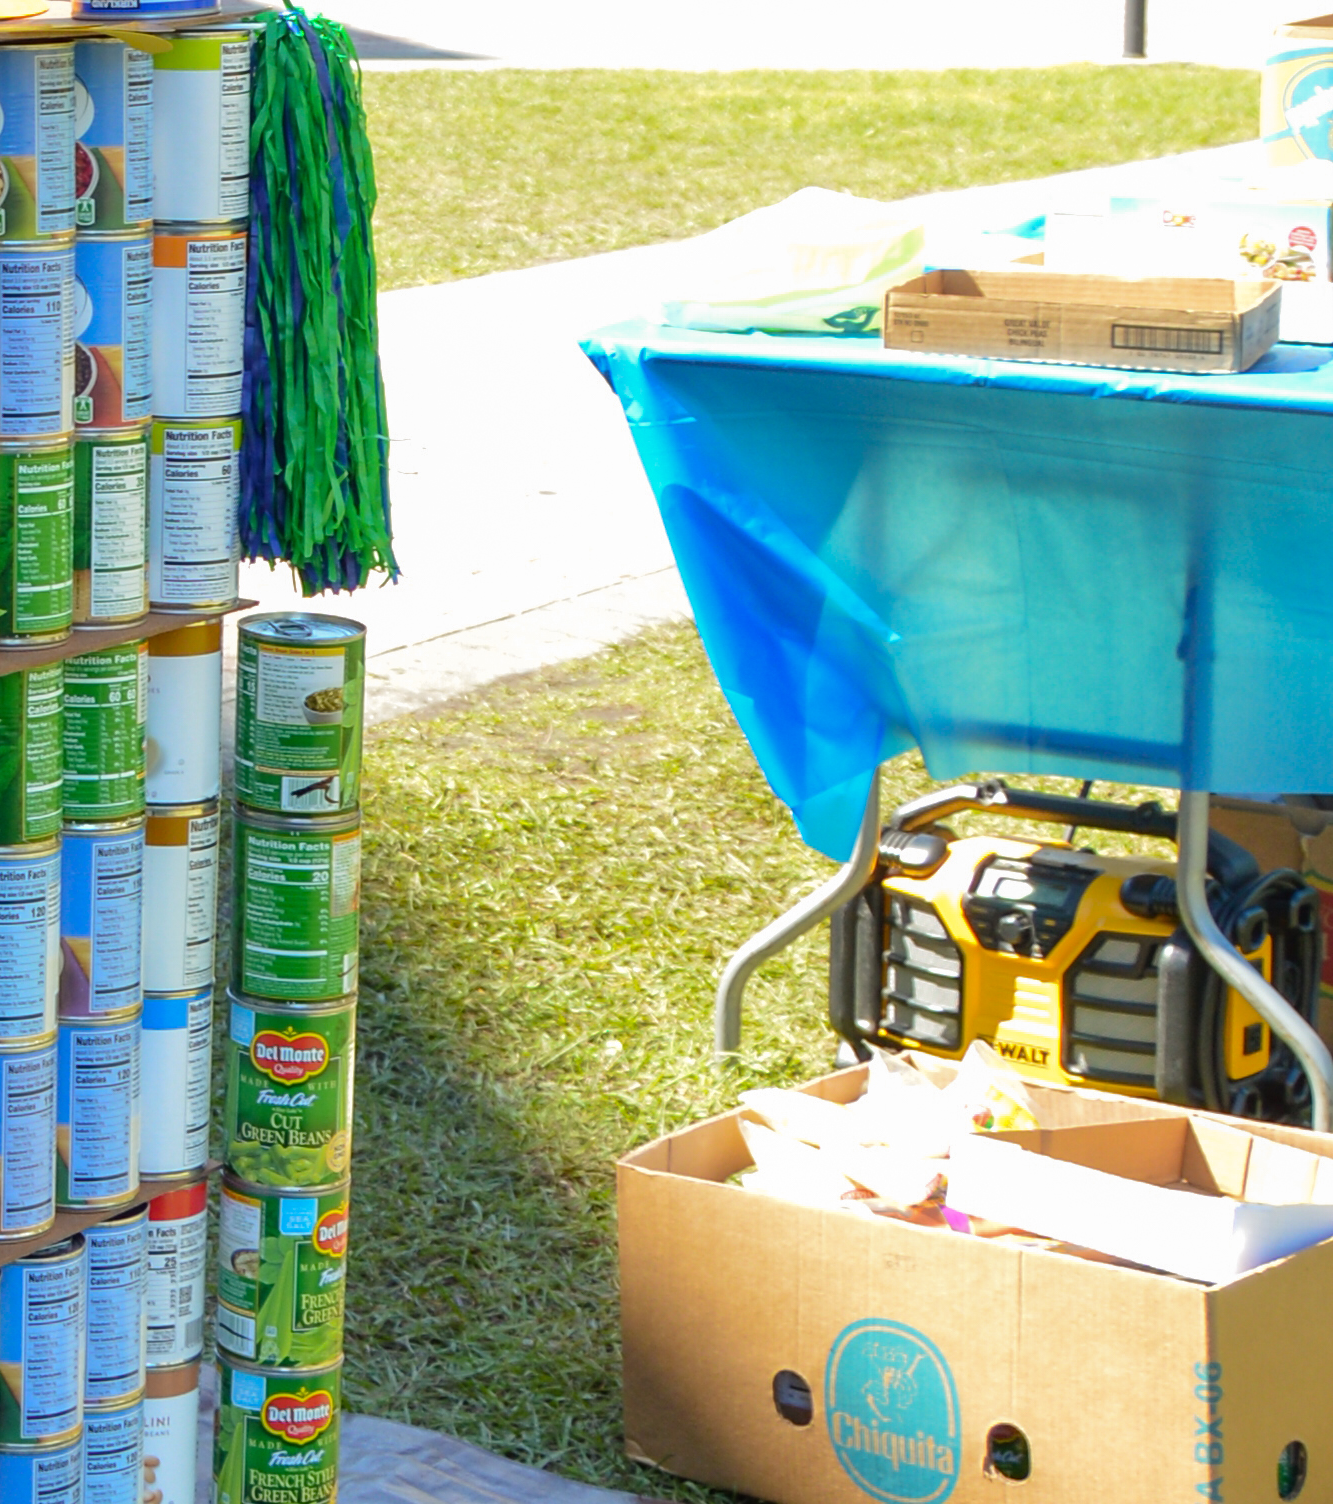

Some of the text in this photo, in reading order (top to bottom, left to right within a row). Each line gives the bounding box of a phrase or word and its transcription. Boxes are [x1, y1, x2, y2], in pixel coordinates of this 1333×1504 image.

[255, 1043, 324, 1063] Del Monte
[273, 1064, 304, 1076] Quality
[270, 1113, 303, 1130] CUT
[241, 1122, 331, 1145] GREEN BEANS
[1193, 1361, 1224, 1465] BX-06
[833, 1409, 954, 1475] Chiquita
[249, 1467, 305, 1488] FRENCH
[251, 1484, 299, 1503] GREEN
